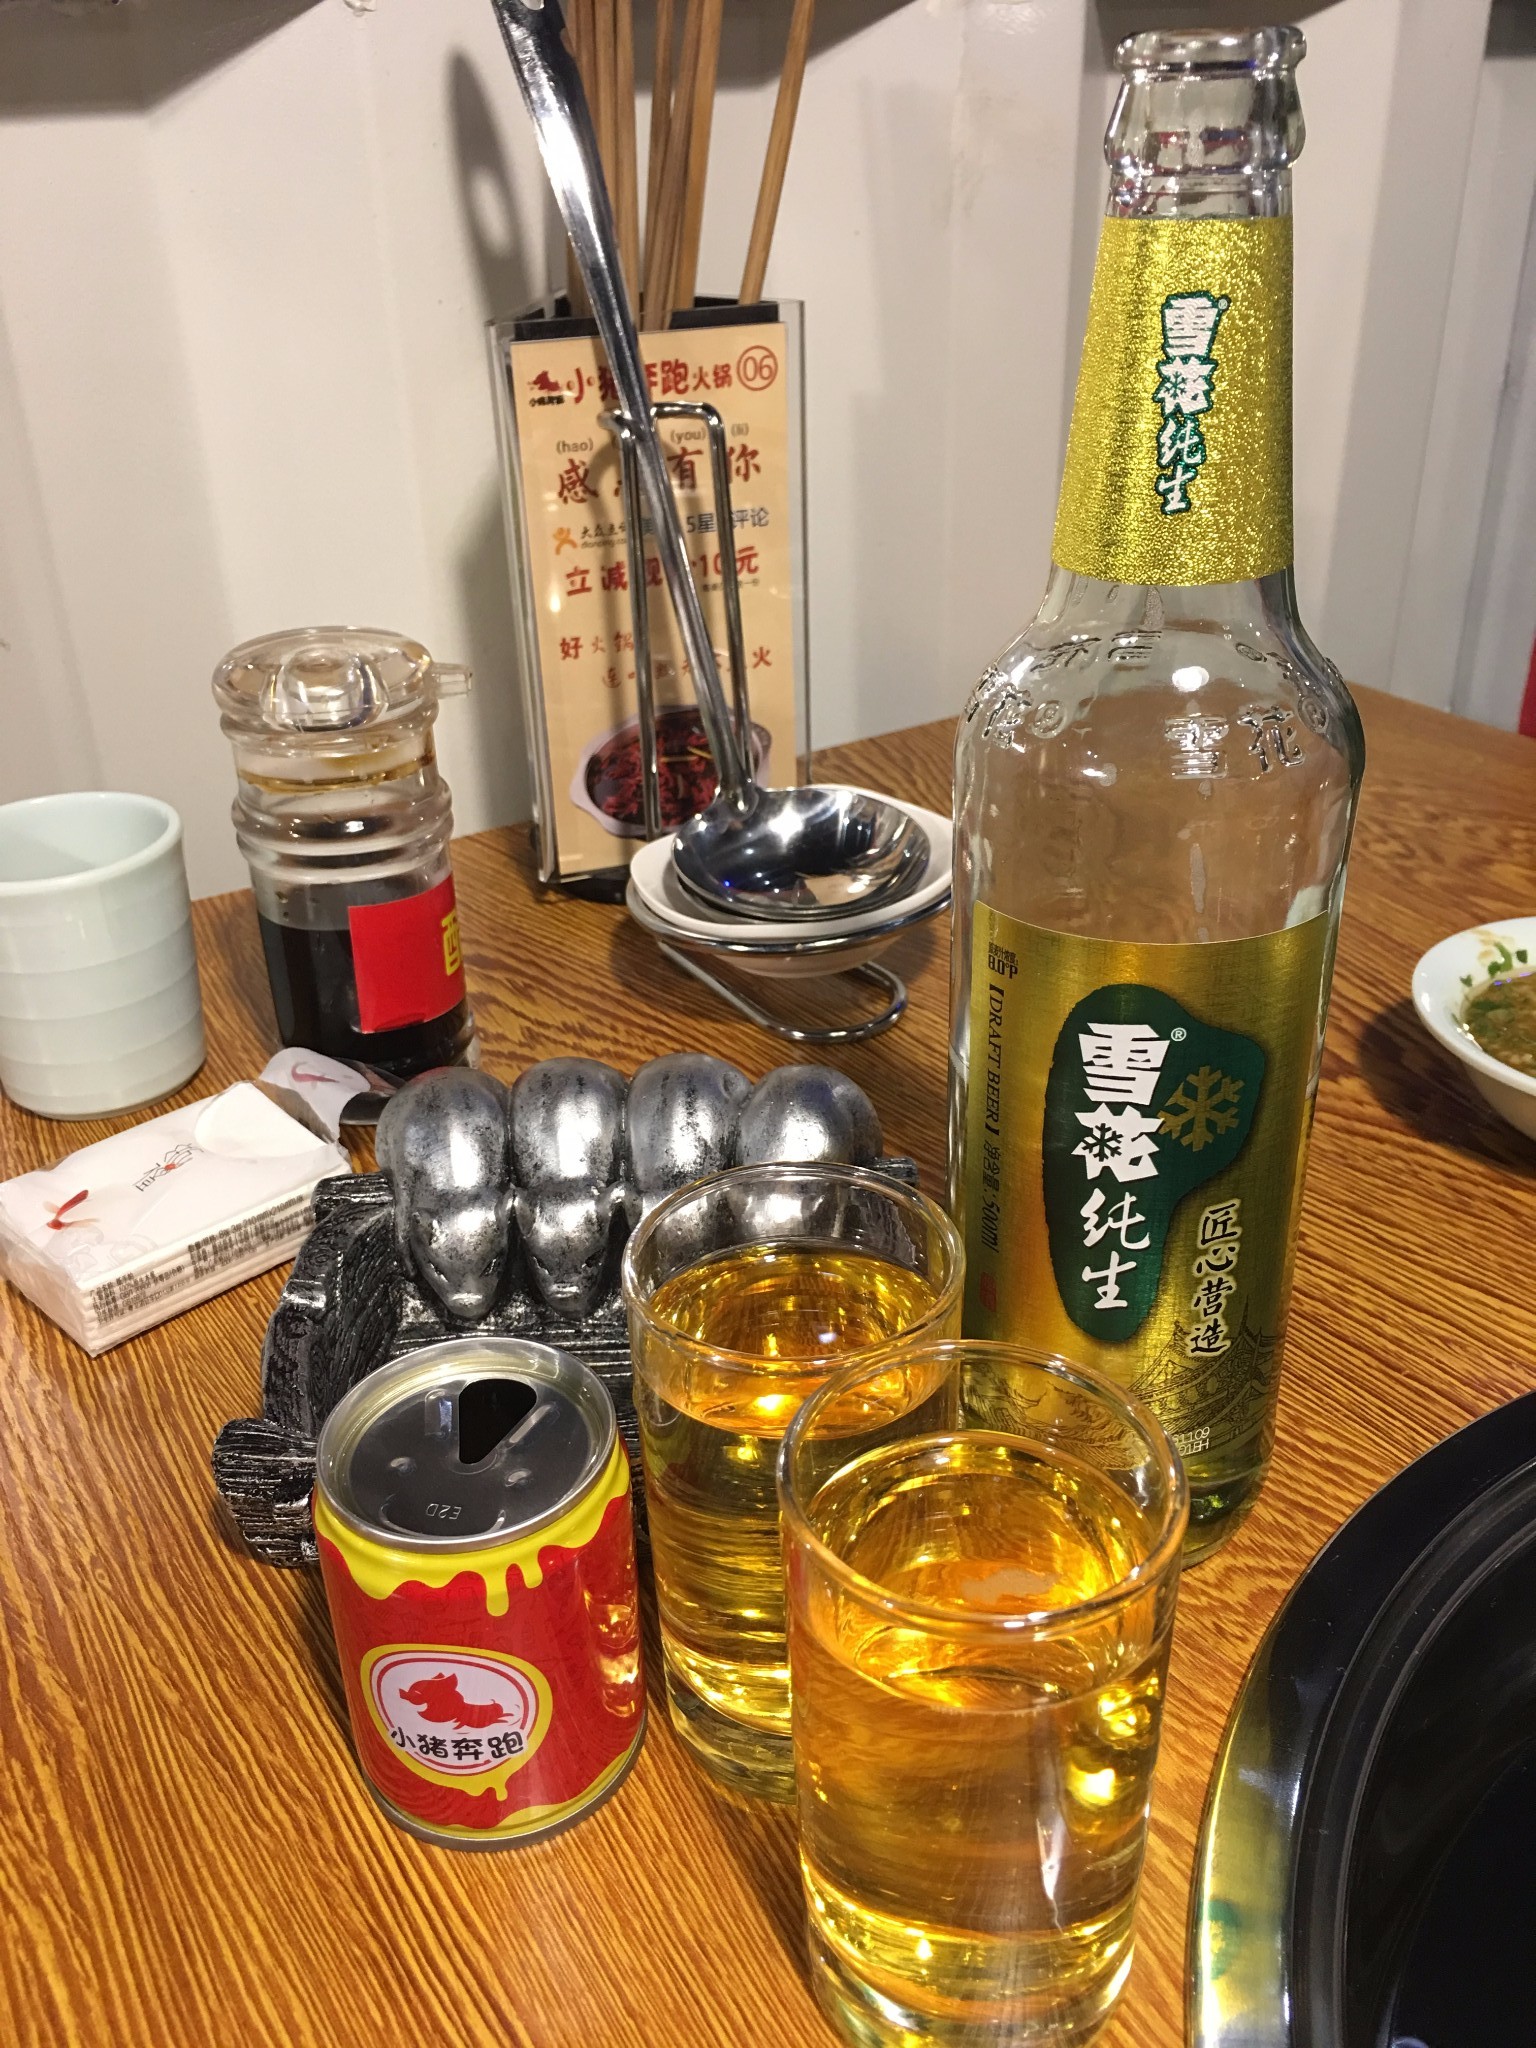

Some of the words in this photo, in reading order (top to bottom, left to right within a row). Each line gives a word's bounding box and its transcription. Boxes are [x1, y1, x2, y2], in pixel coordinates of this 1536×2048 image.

[743, 355, 774, 382] 06
[1154, 297, 1220, 512] 雪花纯生
[556, 438, 594, 454] (hao)
[670, 428, 706, 444] (you)
[1071, 1022, 1170, 1310] 雪花纯生
[1191, 1201, 1239, 1353] 匠心营造
[391, 1726, 524, 1760] 小猪奔跑
